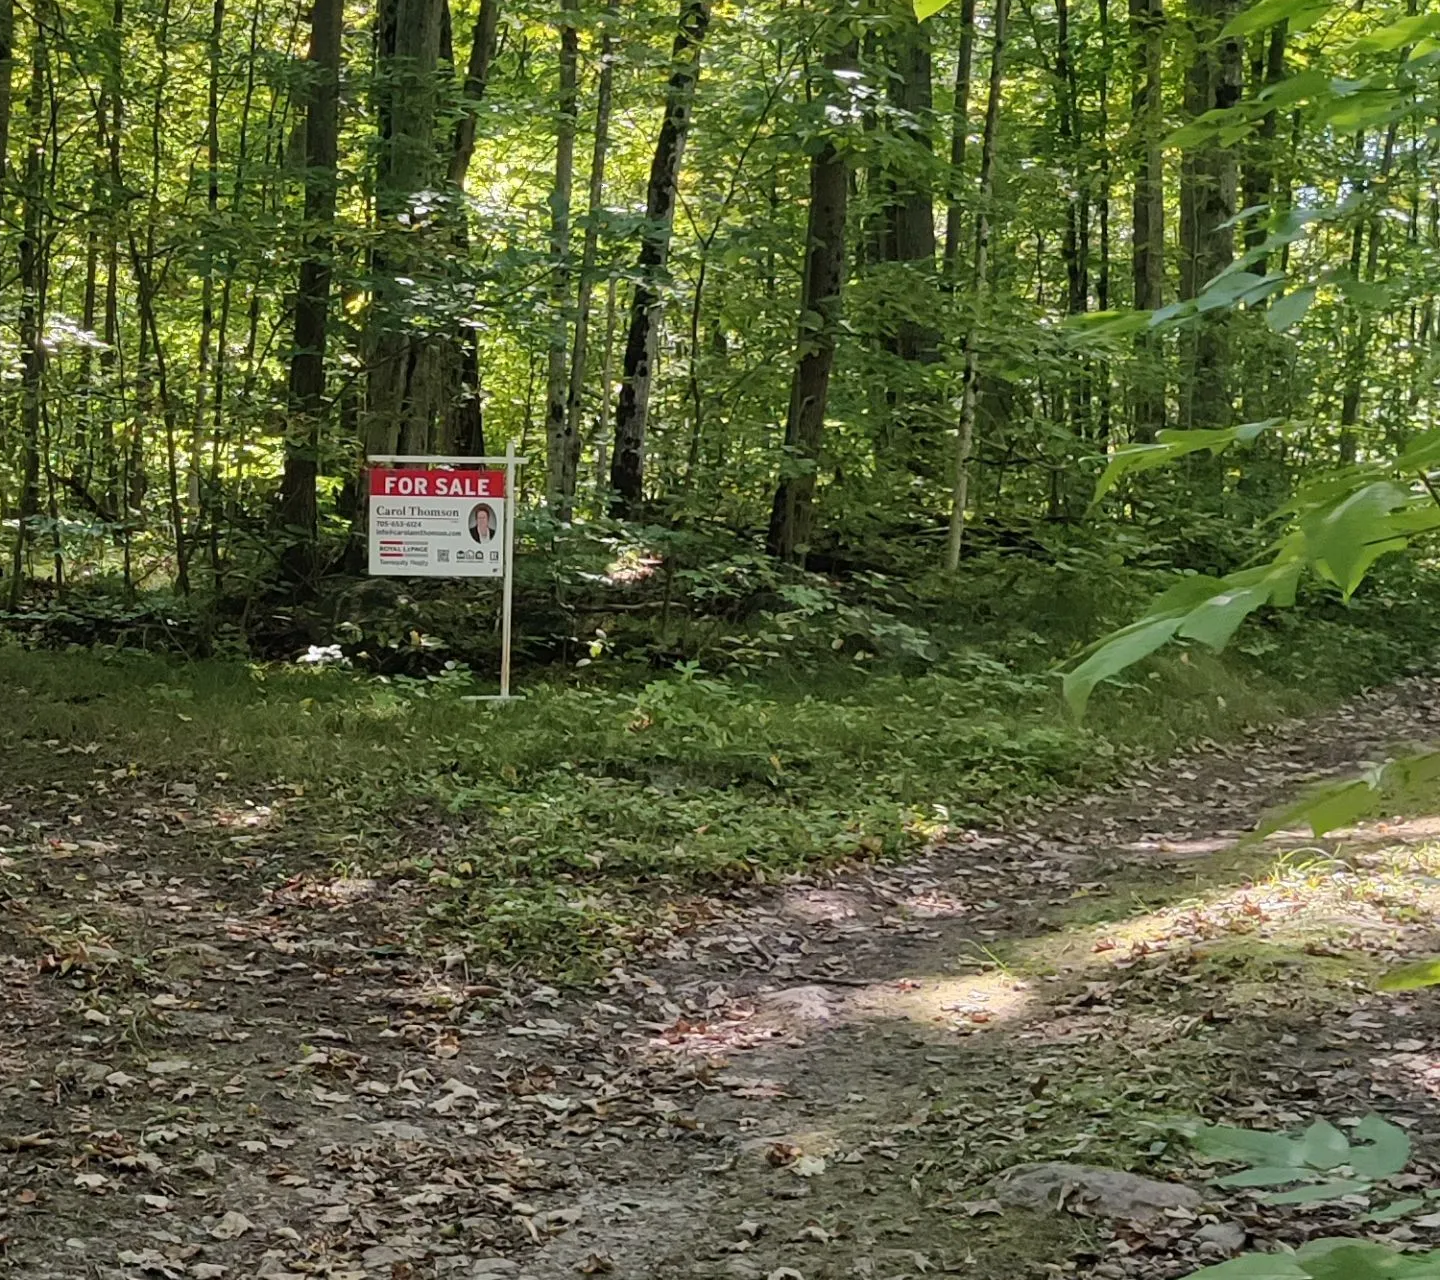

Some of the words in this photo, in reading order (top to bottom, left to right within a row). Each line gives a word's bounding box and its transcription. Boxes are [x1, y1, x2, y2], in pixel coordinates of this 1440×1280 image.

[385, 477, 428, 494] FOR
[435, 478, 490, 496] SALE
[376, 506, 406, 516] Carol
[408, 506, 459, 517] Thomson
